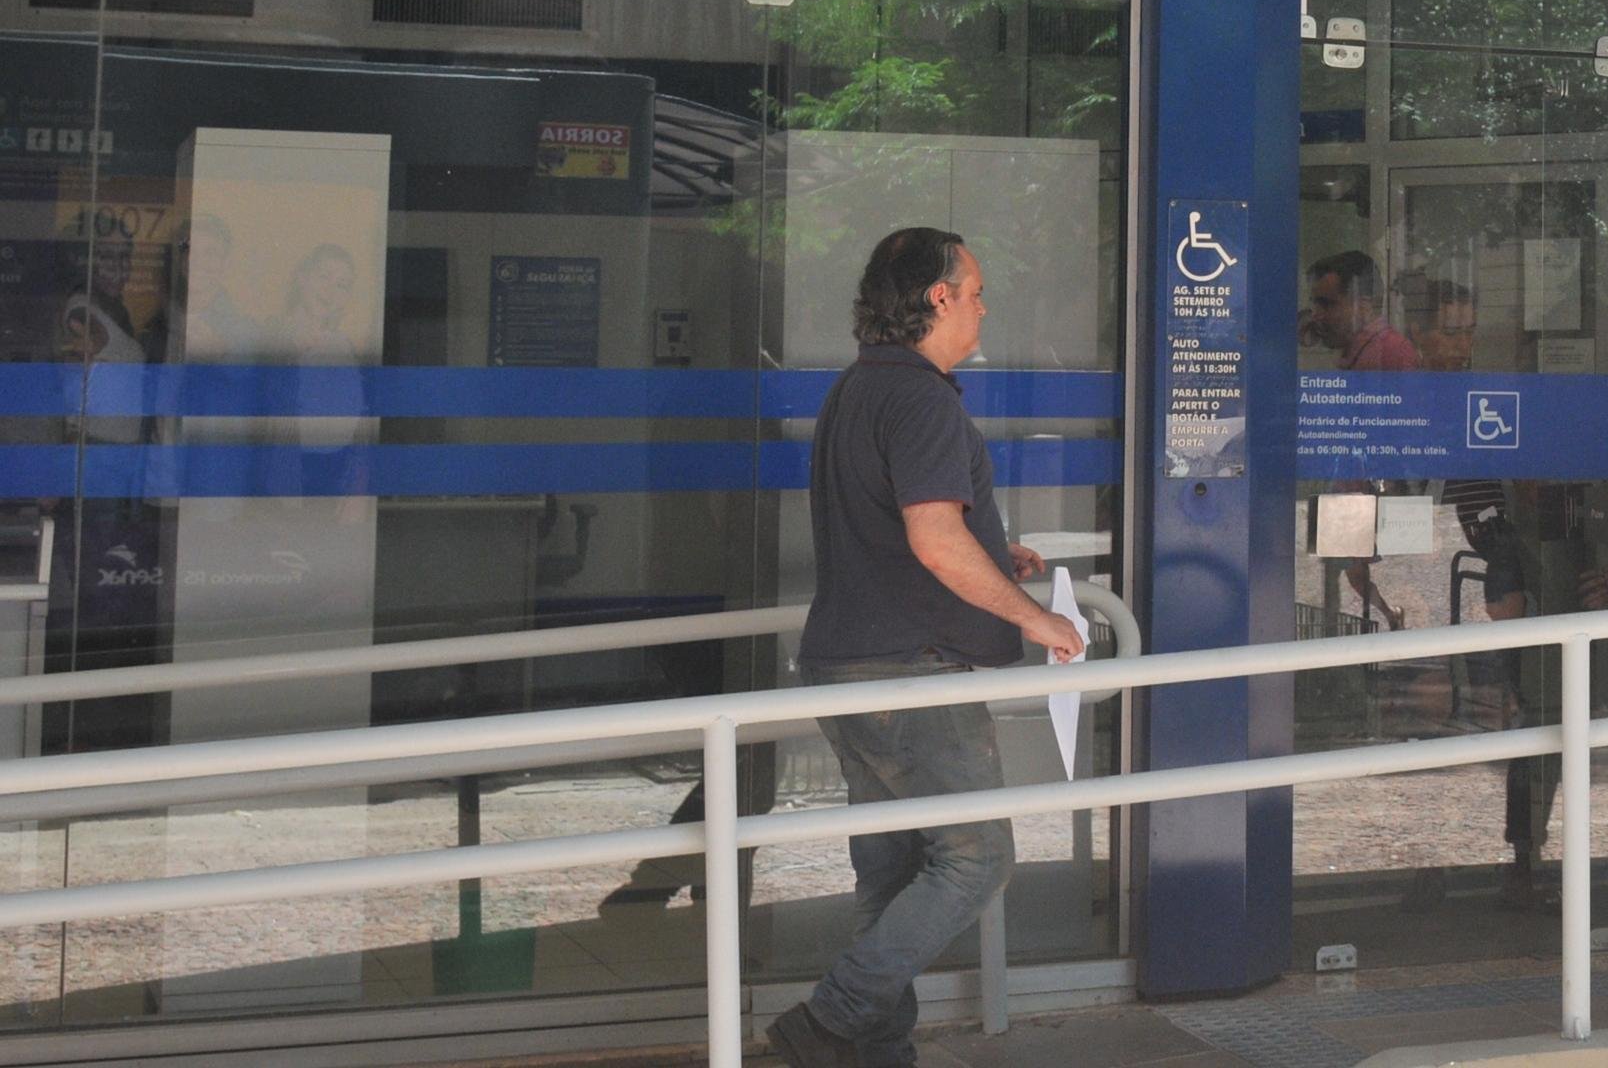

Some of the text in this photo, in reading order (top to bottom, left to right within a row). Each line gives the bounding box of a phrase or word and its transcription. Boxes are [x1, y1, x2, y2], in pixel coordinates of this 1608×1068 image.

[1173, 286, 1231, 295] AG. SETE DE
[1173, 297, 1224, 307] SETEMBRO
[1174, 307, 1193, 317] 10H
[1210, 308, 1230, 317] 16H
[1172, 339, 1199, 349] AUTO
[1172, 352, 1241, 361] ATENDIMENTO
[1172, 364, 1186, 373] 6H
[1203, 364, 1237, 373] 18:30H
[1300, 376, 1347, 388] Entrada
[1172, 388, 1241, 398] PARA ENTRAR
[1300, 392, 1402, 404] Autoatendimento
[1171, 401, 1220, 410] APERTE O
[1172, 411, 1217, 422] BOTÃO E
[1299, 416, 1431, 426] Horário de Funcionamento:
[1171, 425, 1229, 435] EMPURRE A
[1298, 431, 1367, 440] Autoatendimento
[1171, 438, 1205, 448] PORTA
[1297, 445, 1314, 454] das
[1401, 445, 1421, 455] dias
